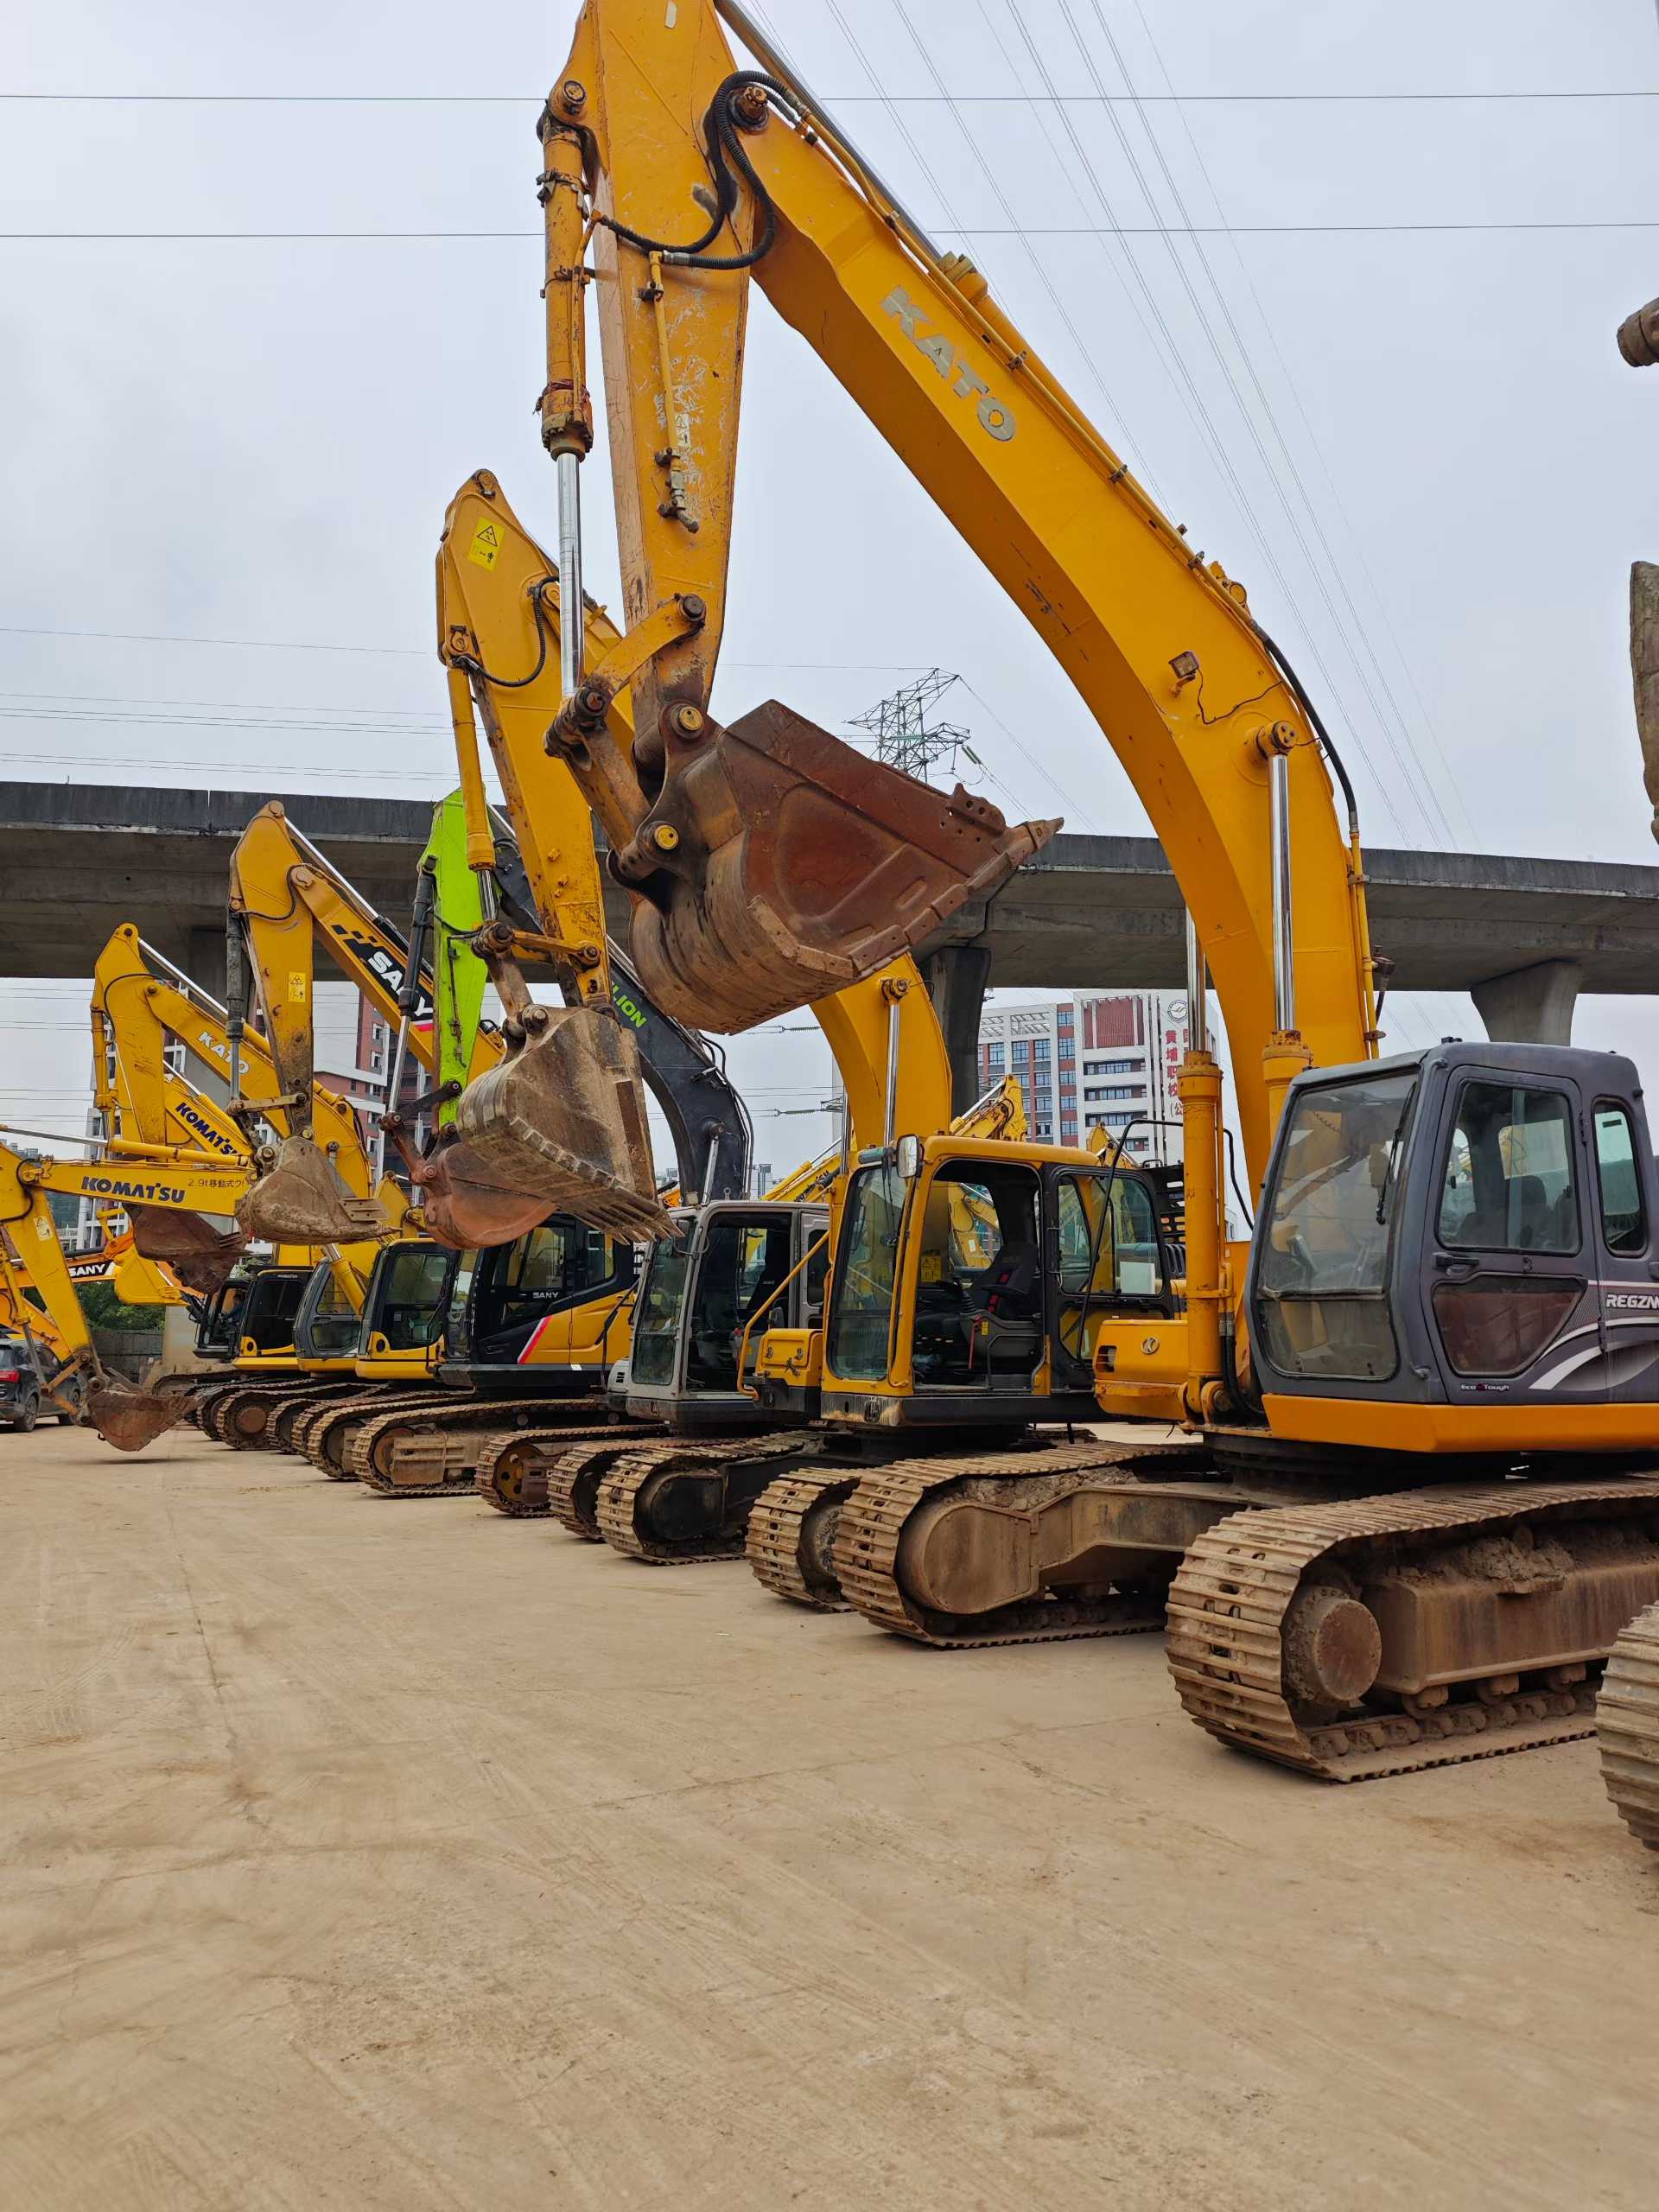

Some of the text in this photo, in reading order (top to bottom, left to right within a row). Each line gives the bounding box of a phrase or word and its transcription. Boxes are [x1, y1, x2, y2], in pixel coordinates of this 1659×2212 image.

[880, 284, 1017, 442] KATO
[367, 950, 433, 1017] SAY
[176, 1102, 239, 1156] KOMATS
[81, 1176, 185, 1204] KOMATSU
[69, 1263, 106, 1278] SANY
